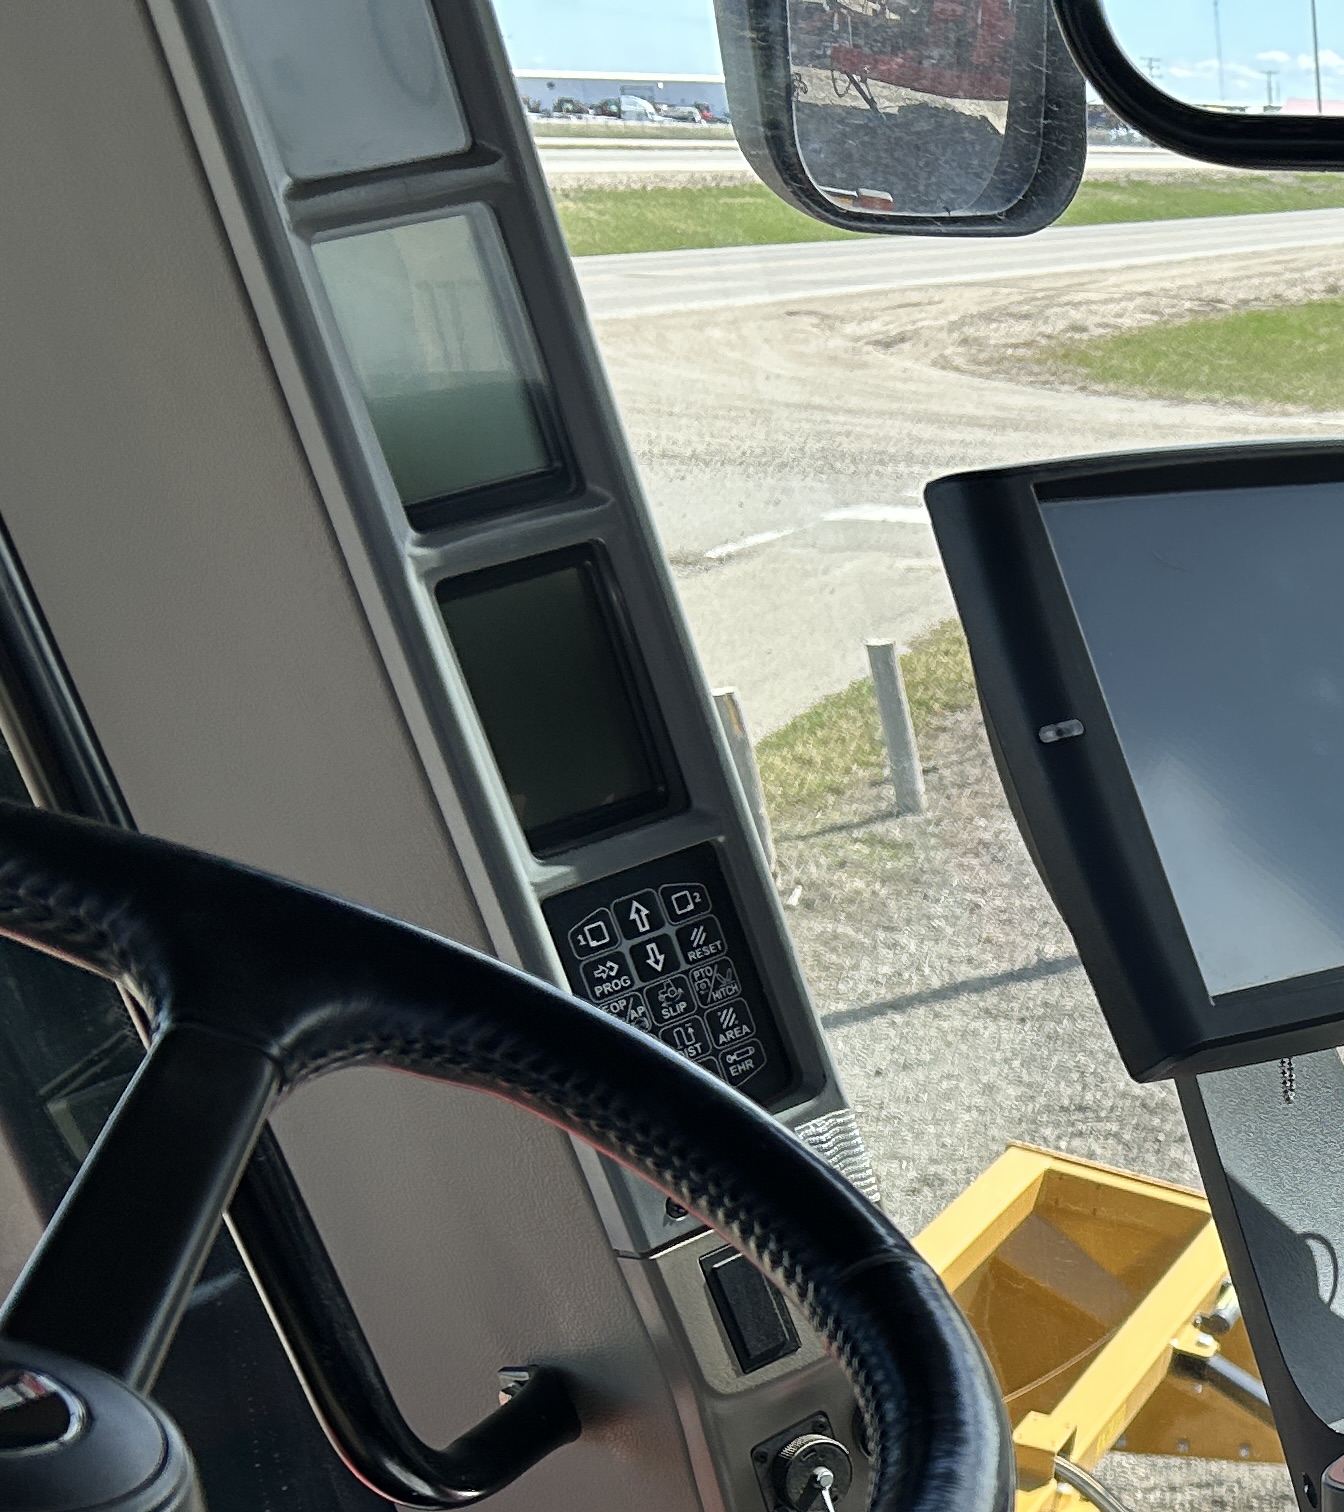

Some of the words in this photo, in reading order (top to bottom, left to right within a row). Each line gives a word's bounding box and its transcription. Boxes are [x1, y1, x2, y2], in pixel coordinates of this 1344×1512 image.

[687, 940, 722, 962] RESET
[693, 966, 713, 981] PTO
[594, 975, 631, 998] PROG
[712, 982, 739, 1001] HITCH
[661, 1001, 687, 1020] SLIP
[718, 1024, 751, 1045] AREA
[729, 1059, 755, 1077] EHR
